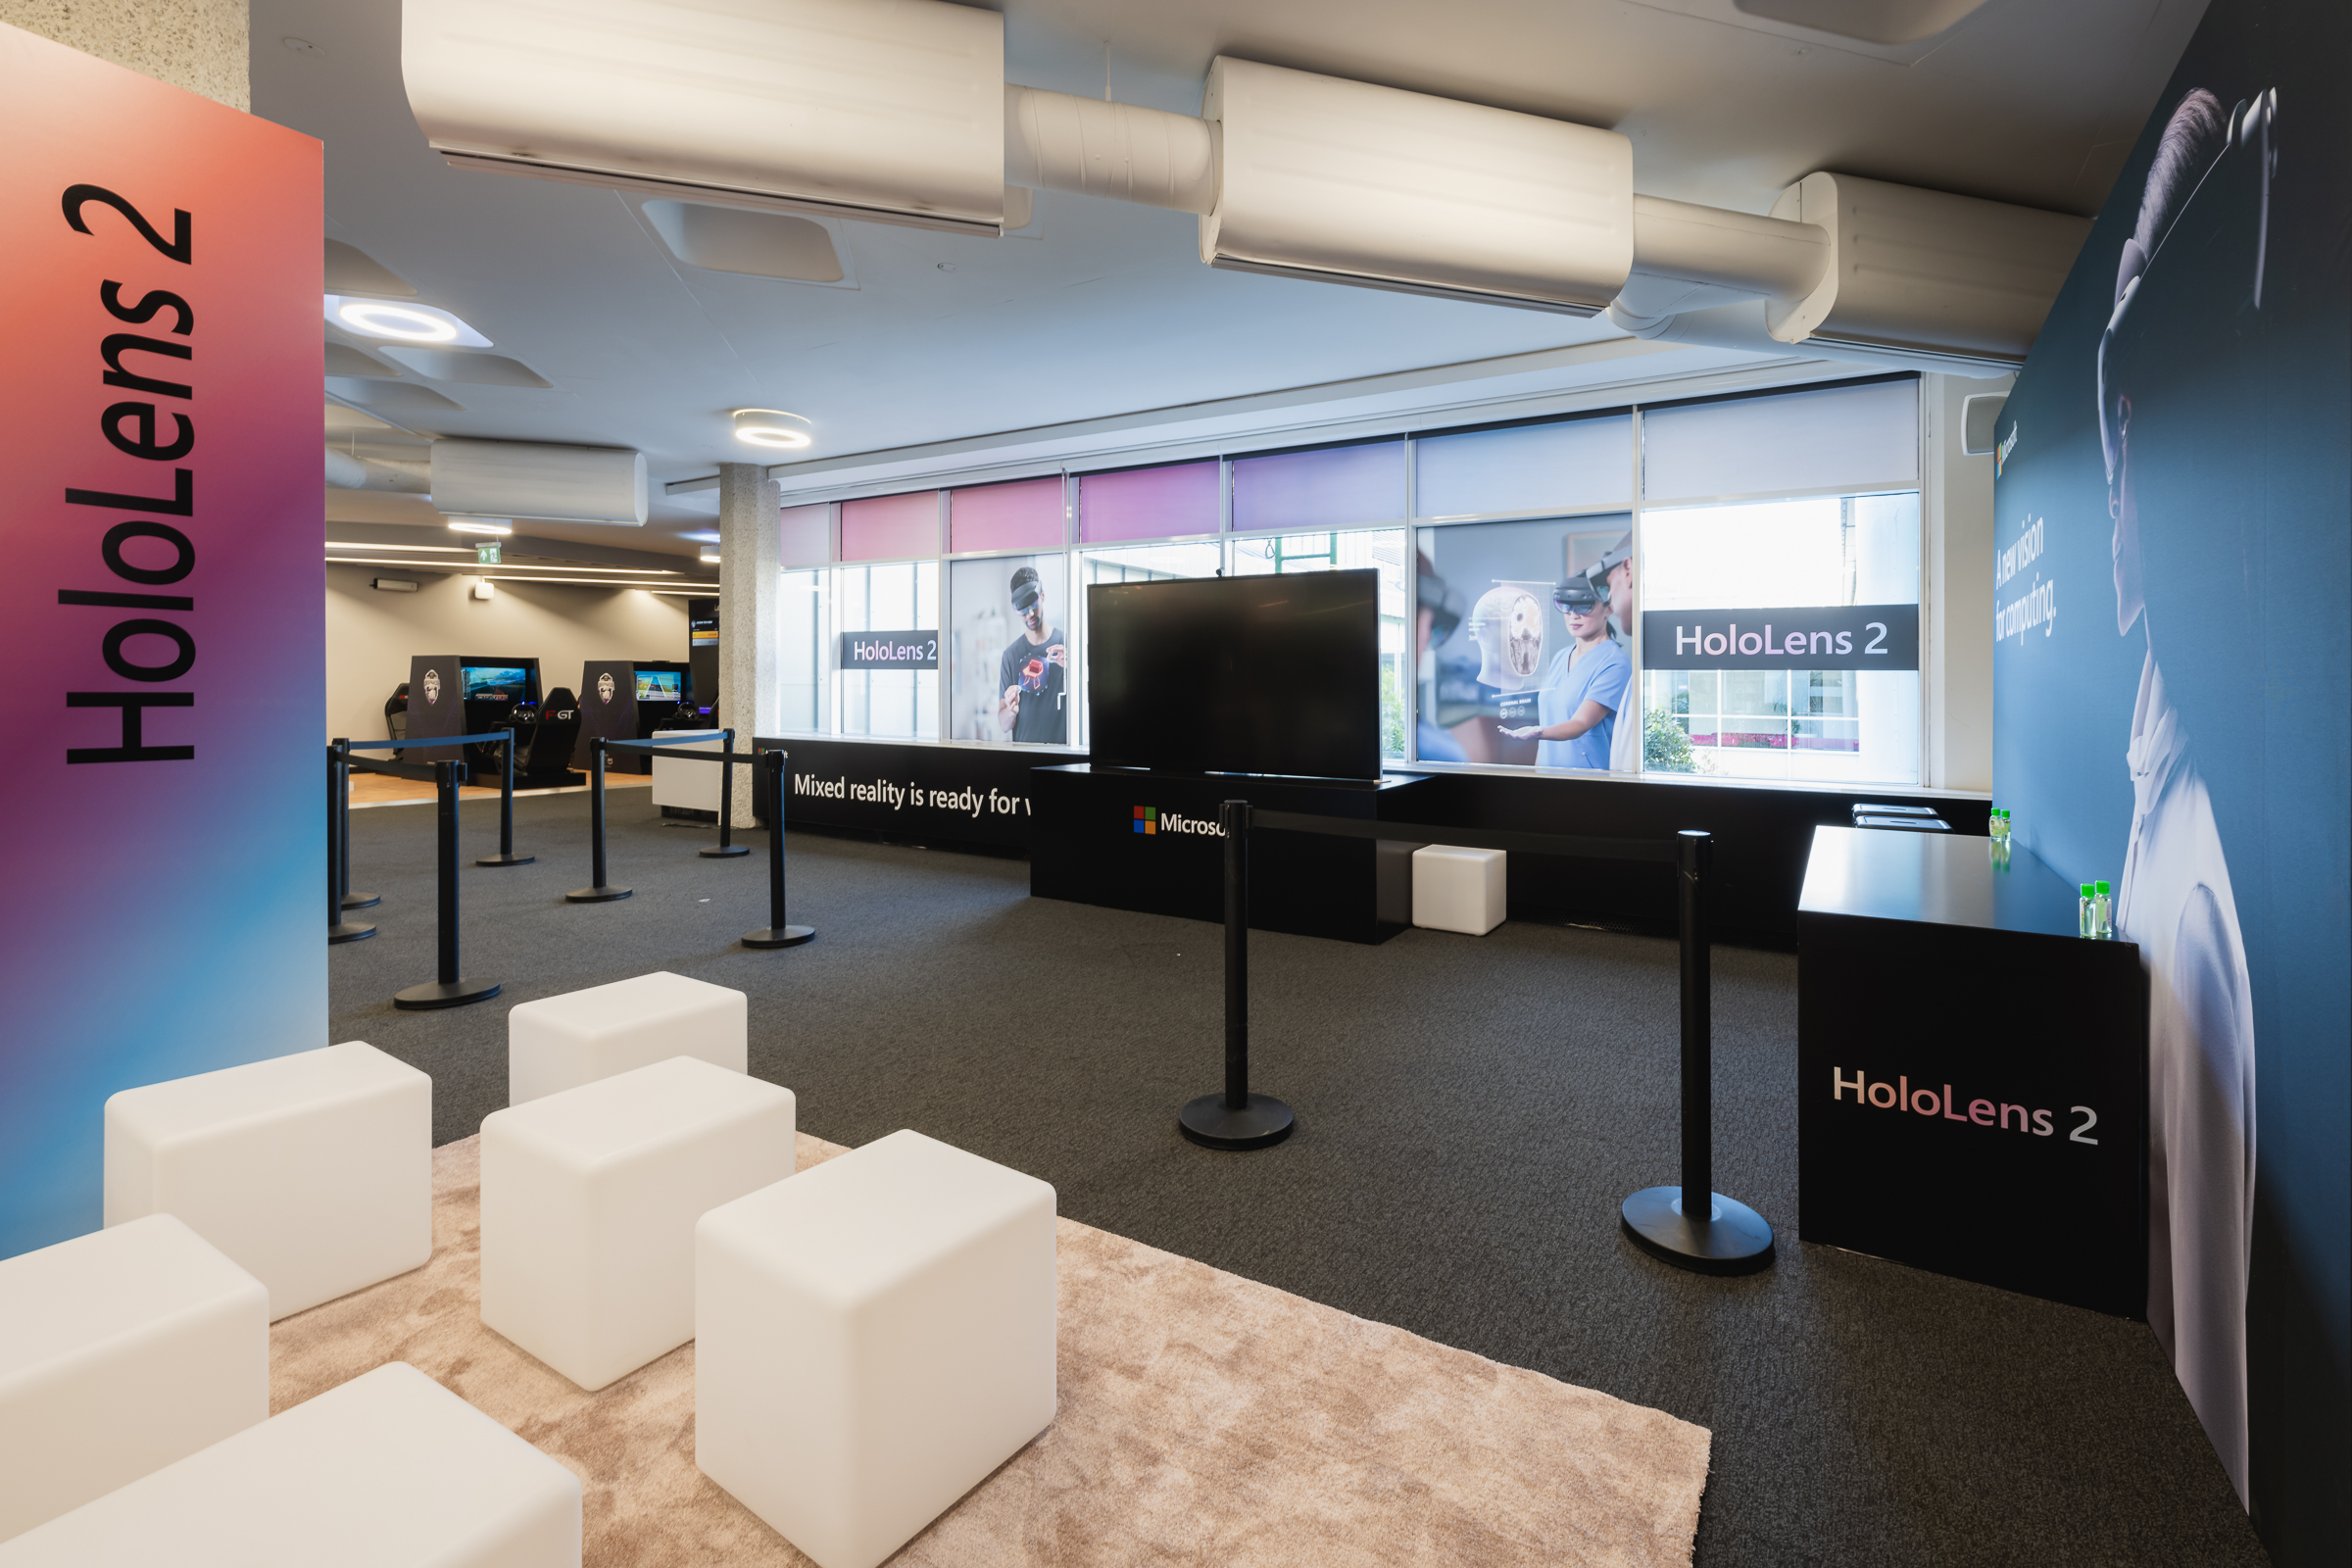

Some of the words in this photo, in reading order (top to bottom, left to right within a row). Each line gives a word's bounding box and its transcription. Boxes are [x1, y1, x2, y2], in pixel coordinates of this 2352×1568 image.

[61, 183, 192, 266] 2
[58, 278, 196, 764] HoloLens
[1995, 549, 2002, 591] A
[2002, 542, 2017, 585] new
[2017, 513, 2044, 572] vision
[1676, 623, 1853, 656] HoloLens
[1864, 621, 1888, 655] 2
[1995, 599, 2006, 643] for
[2006, 571, 2057, 647] computing.
[854, 639, 924, 662] HoloLens
[926, 639, 937, 662] 2
[794, 773, 846, 799] Mixed
[850, 778, 906, 811] reality
[909, 781, 924, 807] is
[929, 785, 984, 819] ready
[988, 787, 1020, 815] for
[1160, 812, 1226, 838] Microso
[1834, 1065, 2054, 1137] HoloLens
[2069, 1104, 2099, 1146] 2
